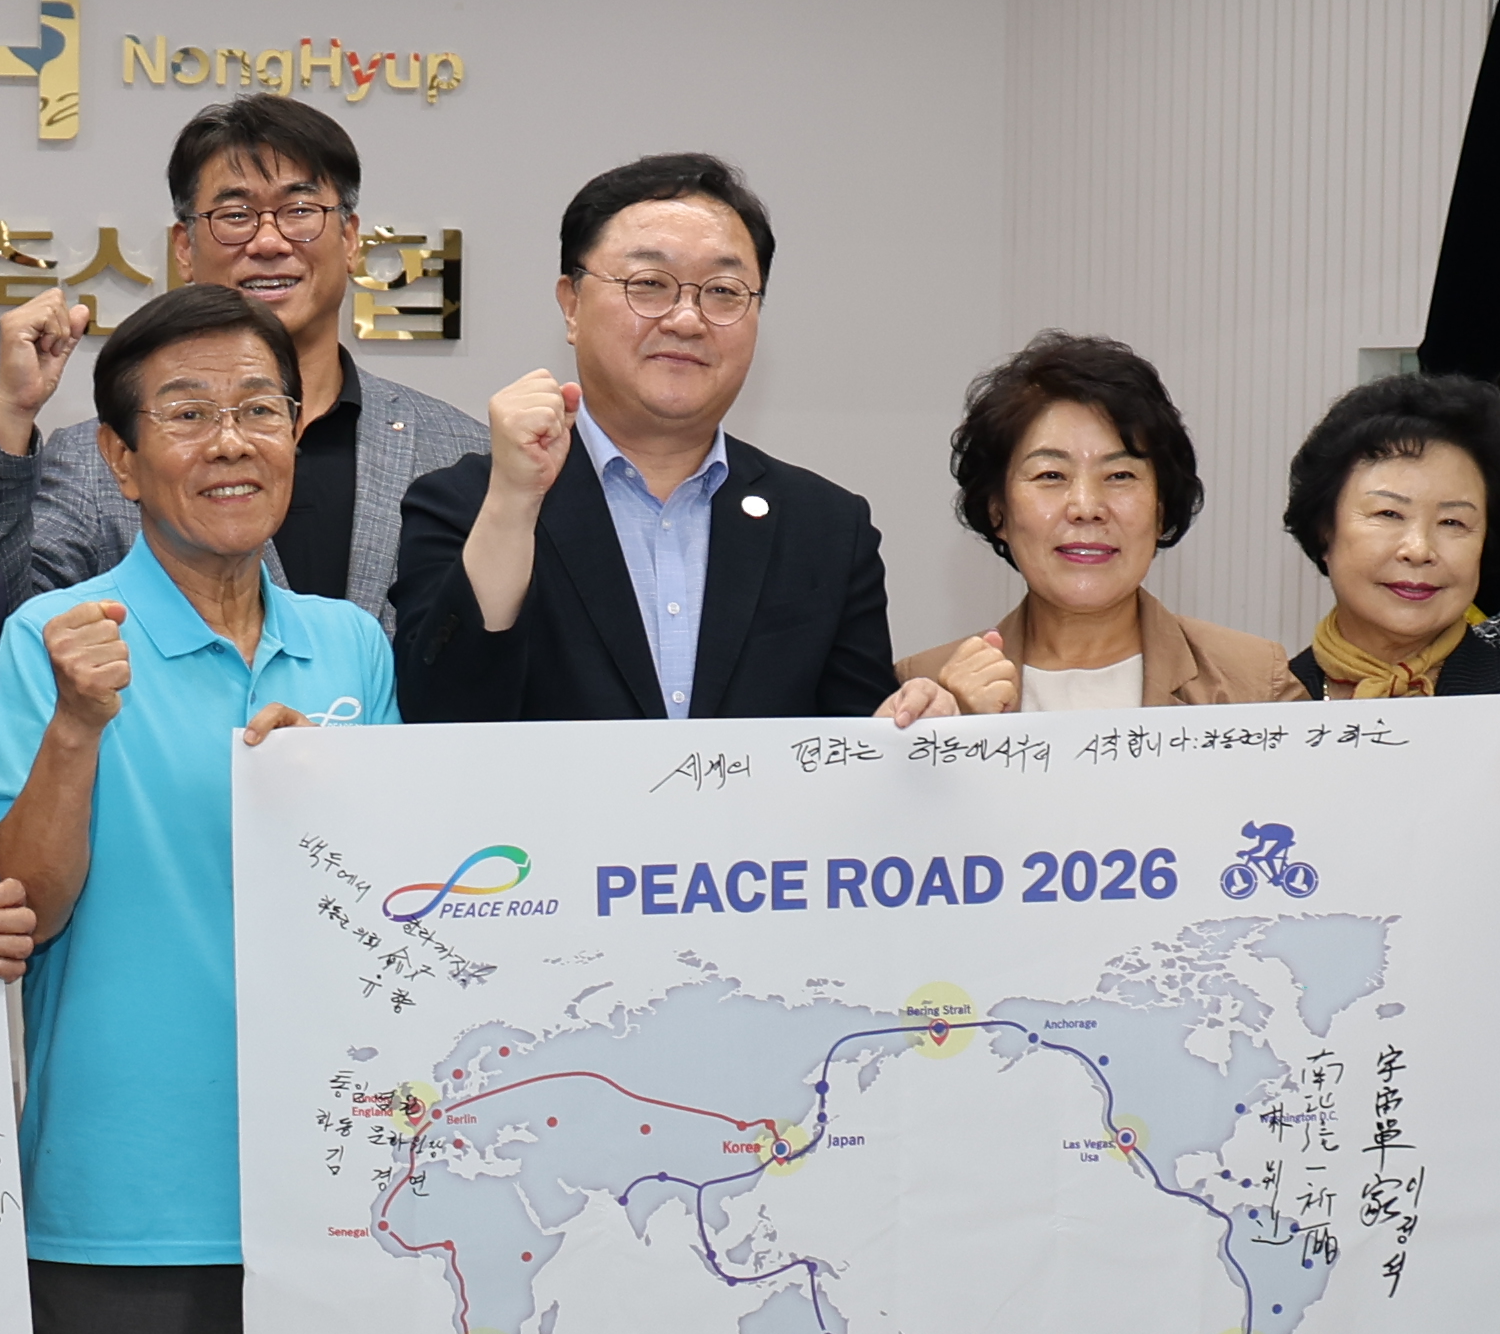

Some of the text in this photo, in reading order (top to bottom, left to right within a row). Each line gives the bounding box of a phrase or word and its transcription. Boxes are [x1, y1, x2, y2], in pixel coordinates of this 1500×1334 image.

[123, 34, 464, 103] NongHyup
[596, 847, 1178, 917] PEACE ROAD 2026
[439, 898, 559, 919] PEACE ROAD
[906, 1003, 972, 1019] Bering Strait
[1044, 1018, 1098, 1033] Anchorage
[352, 1107, 394, 1119] England
[446, 1114, 478, 1125] Berlin
[722, 1140, 763, 1155] Korea
[826, 1132, 866, 1151] Japan
[1063, 1139, 1081, 1151] Las
[1080, 1151, 1100, 1164] Usa
[328, 1226, 370, 1238] Senegal
